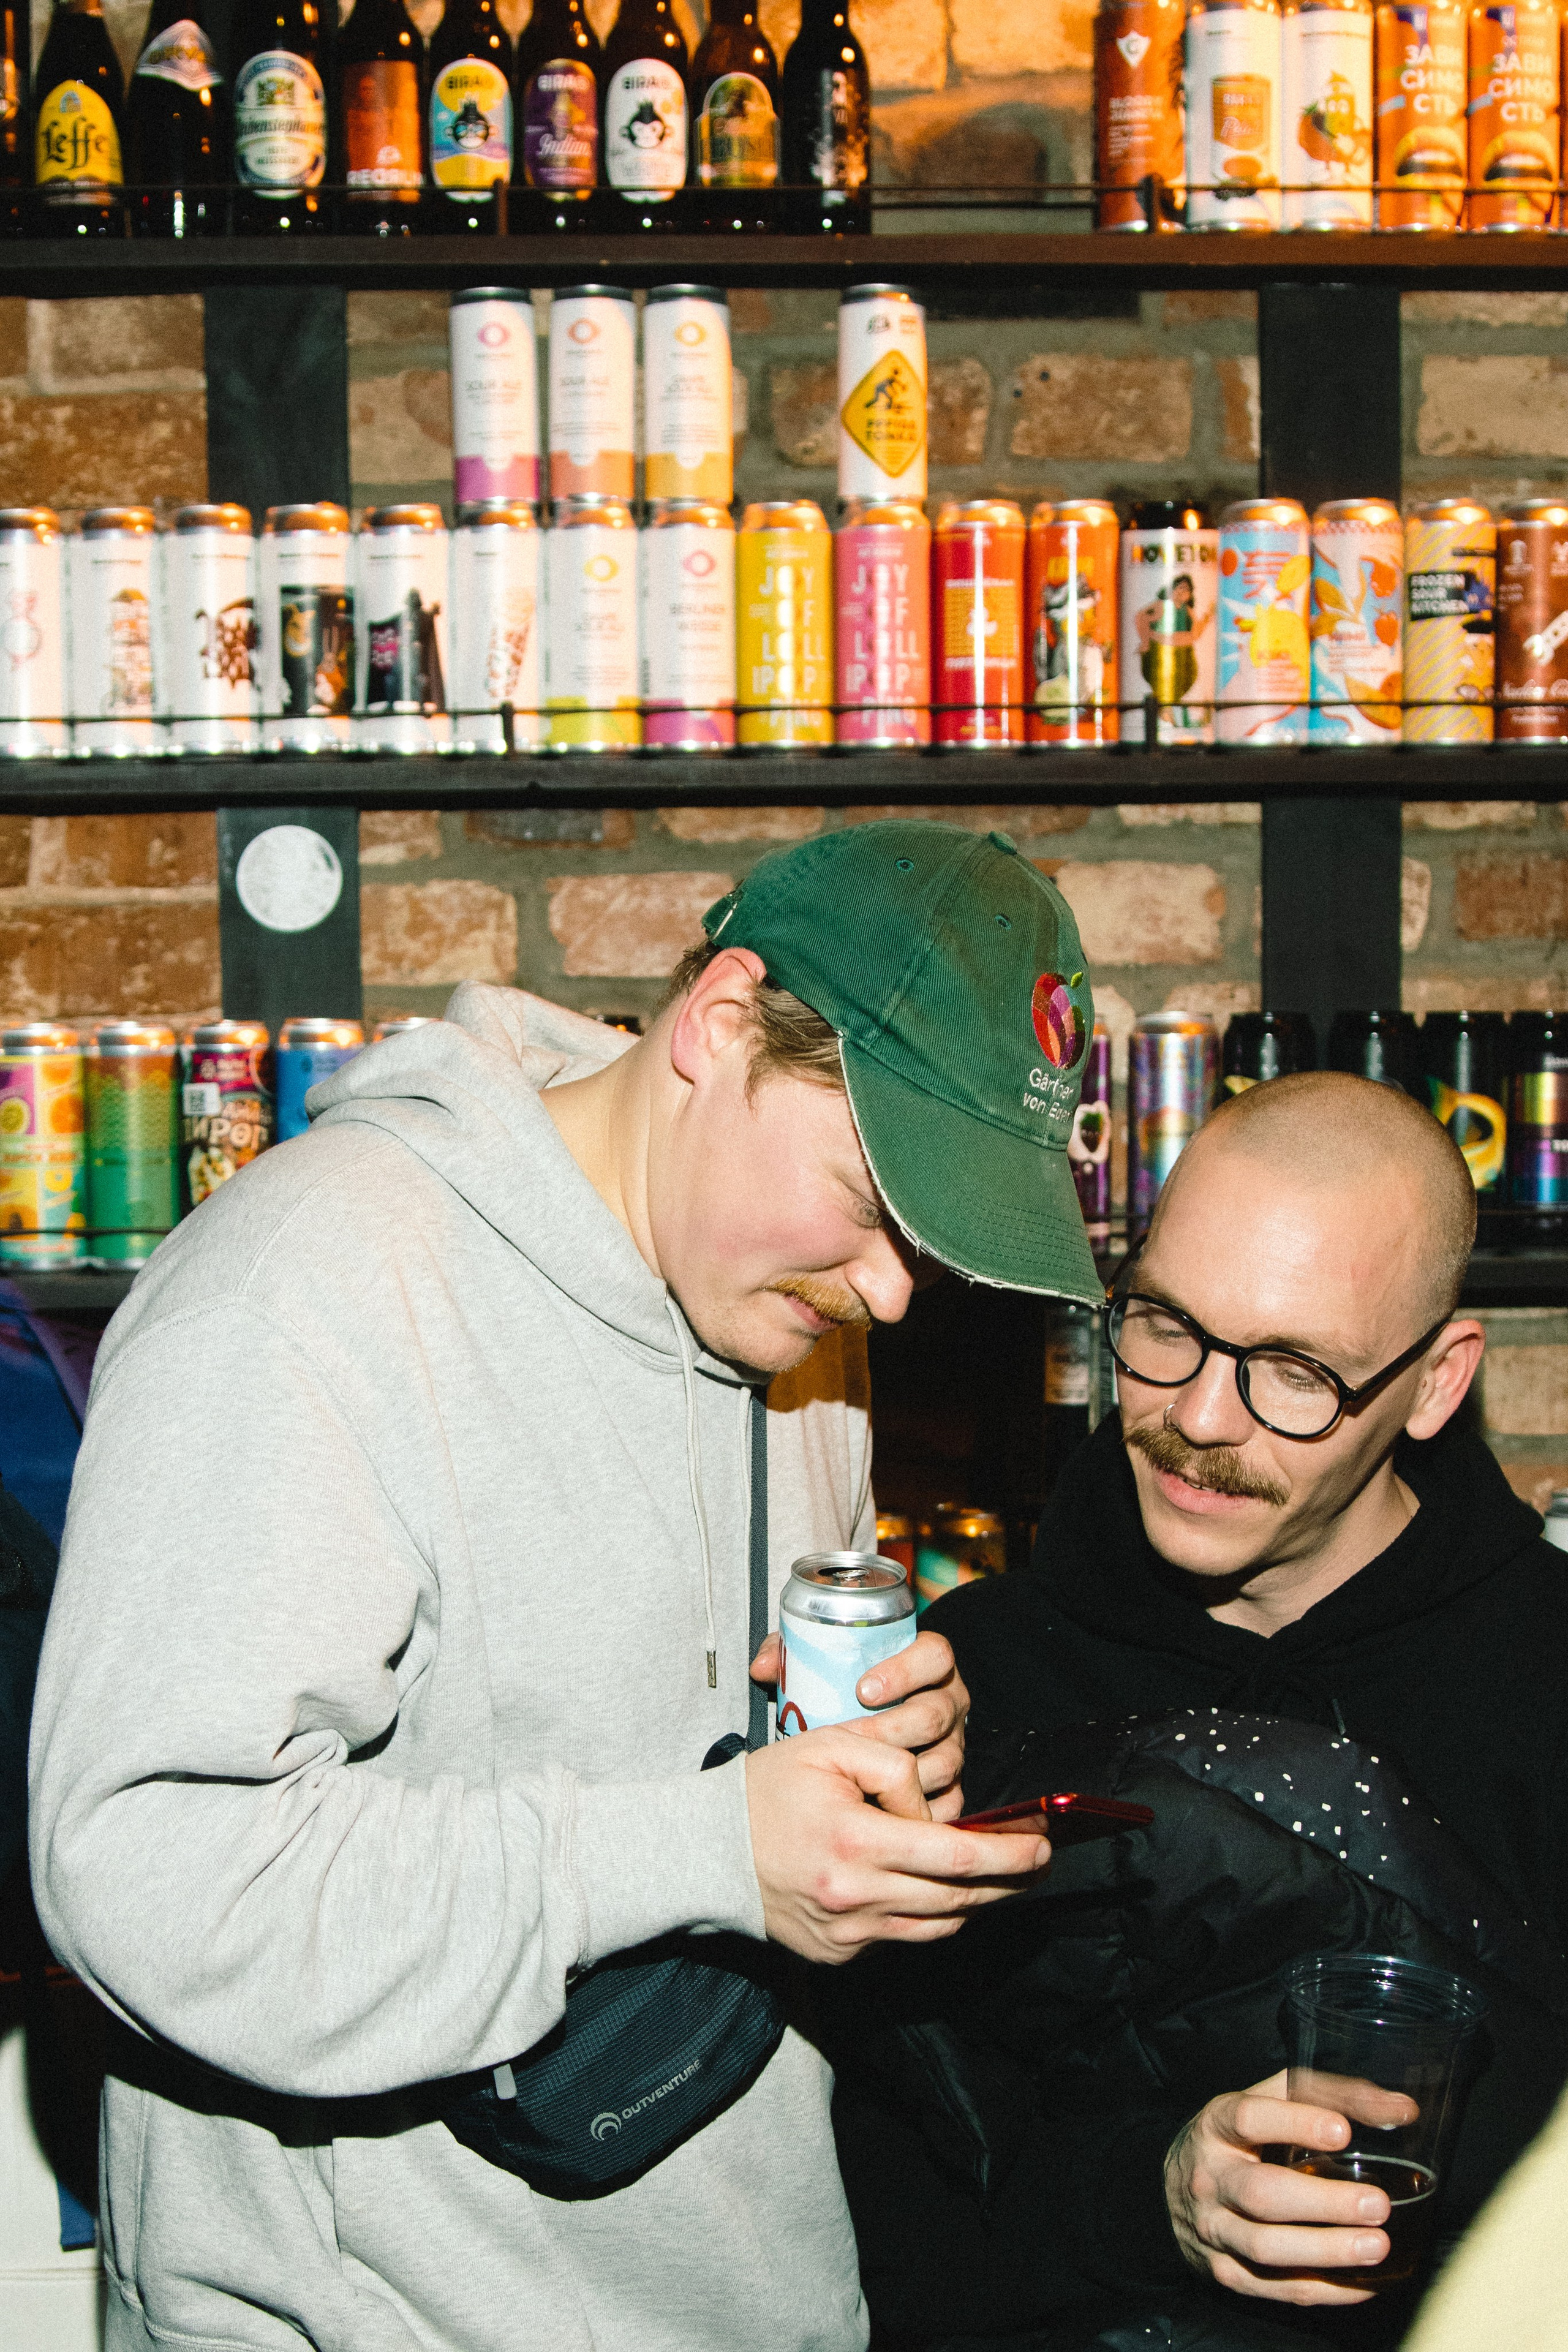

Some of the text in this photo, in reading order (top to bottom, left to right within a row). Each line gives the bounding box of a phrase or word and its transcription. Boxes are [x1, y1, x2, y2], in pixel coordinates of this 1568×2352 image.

[41, 115, 109, 170] Leffe
[1022, 1092, 1046, 1114] von
[1029, 1067, 1074, 1099] Gärtner
[621, 2059, 702, 2119] OUTVENTURE
